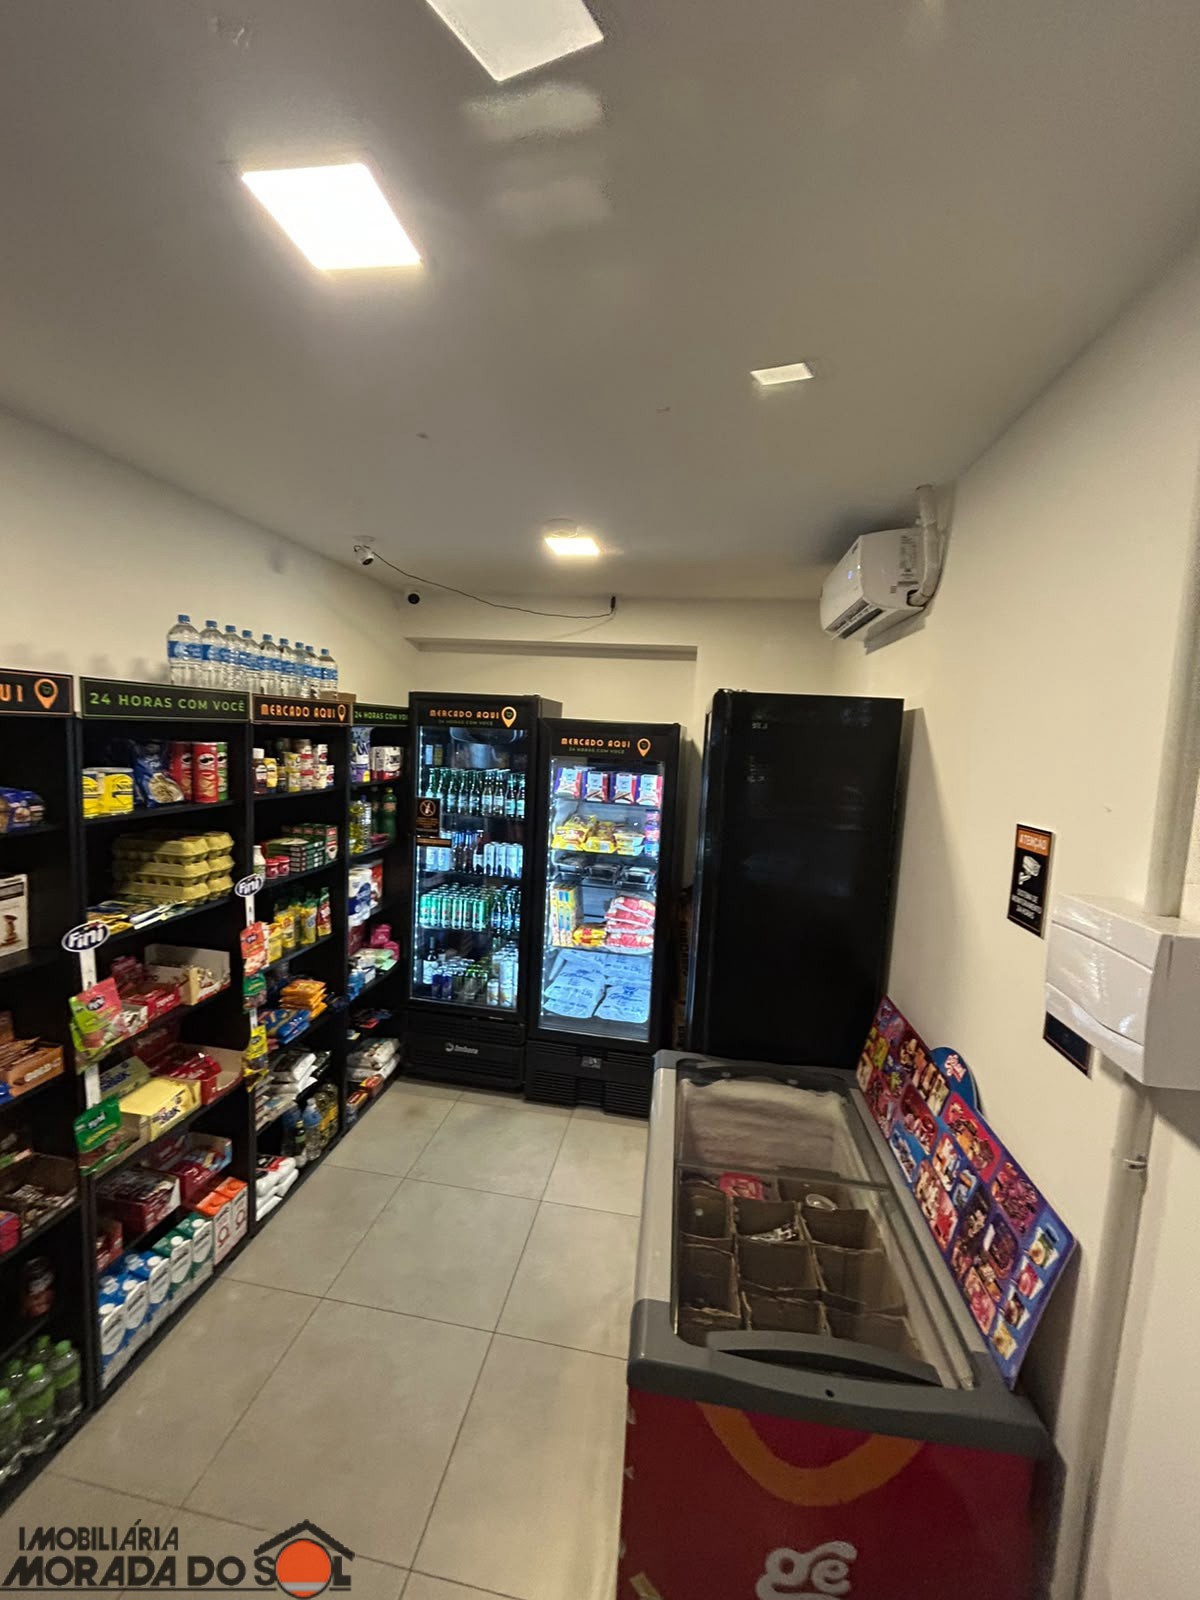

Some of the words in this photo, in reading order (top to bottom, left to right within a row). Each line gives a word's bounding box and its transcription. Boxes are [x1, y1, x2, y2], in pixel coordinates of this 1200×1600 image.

[90, 692, 111, 705] 24
[118, 694, 173, 709] HORAS
[178, 699, 208, 711] COM
[213, 699, 246, 712] VOCÊ
[260, 703, 310, 718] MERCADO
[314, 707, 336, 719] AQUI
[363, 712, 384, 720] HORAS
[429, 708, 473, 719] MERCADO
[476, 710, 500, 720] AQUI
[561, 737, 604, 748] MERCADO
[607, 739, 631, 749] AQUI
